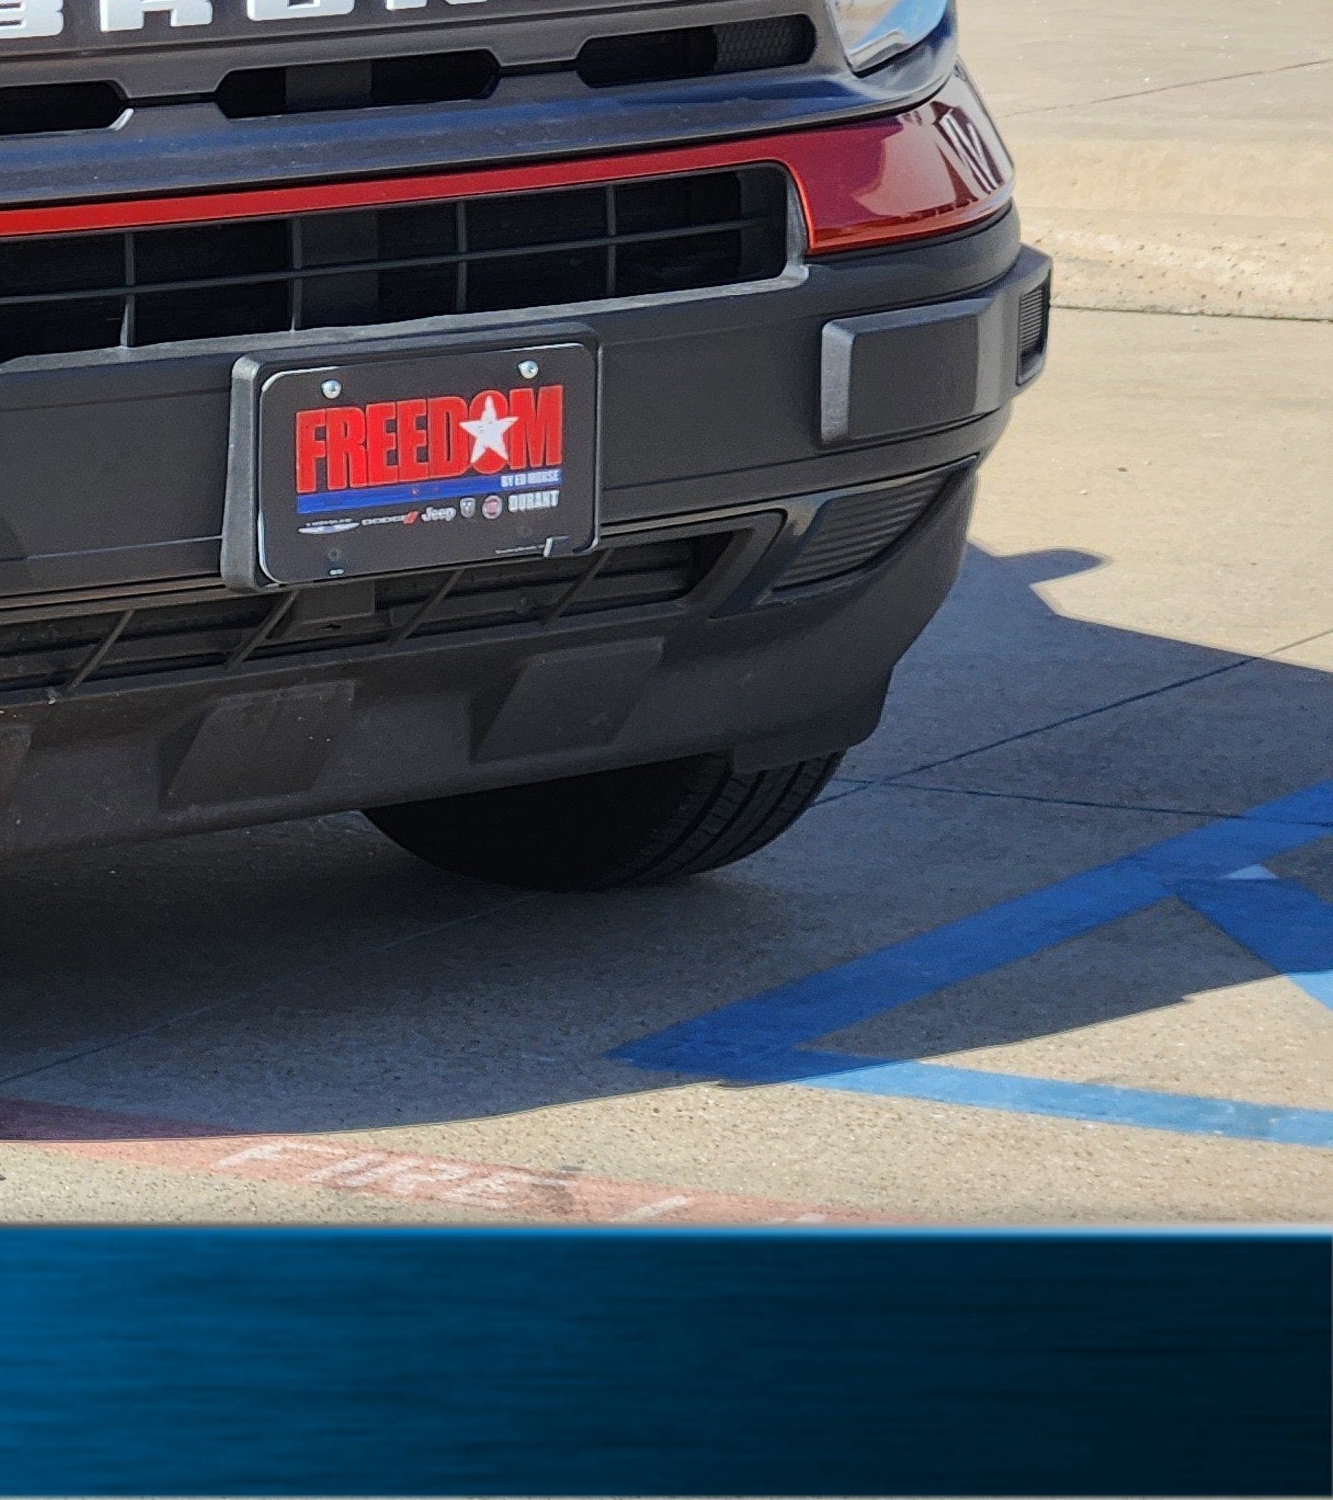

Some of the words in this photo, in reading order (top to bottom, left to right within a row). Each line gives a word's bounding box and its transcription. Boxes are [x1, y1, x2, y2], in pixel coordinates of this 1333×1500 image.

[295, 385, 564, 494] FREEDOM
[508, 490, 560, 513] DURANT
[421, 506, 457, 521] Jeep
